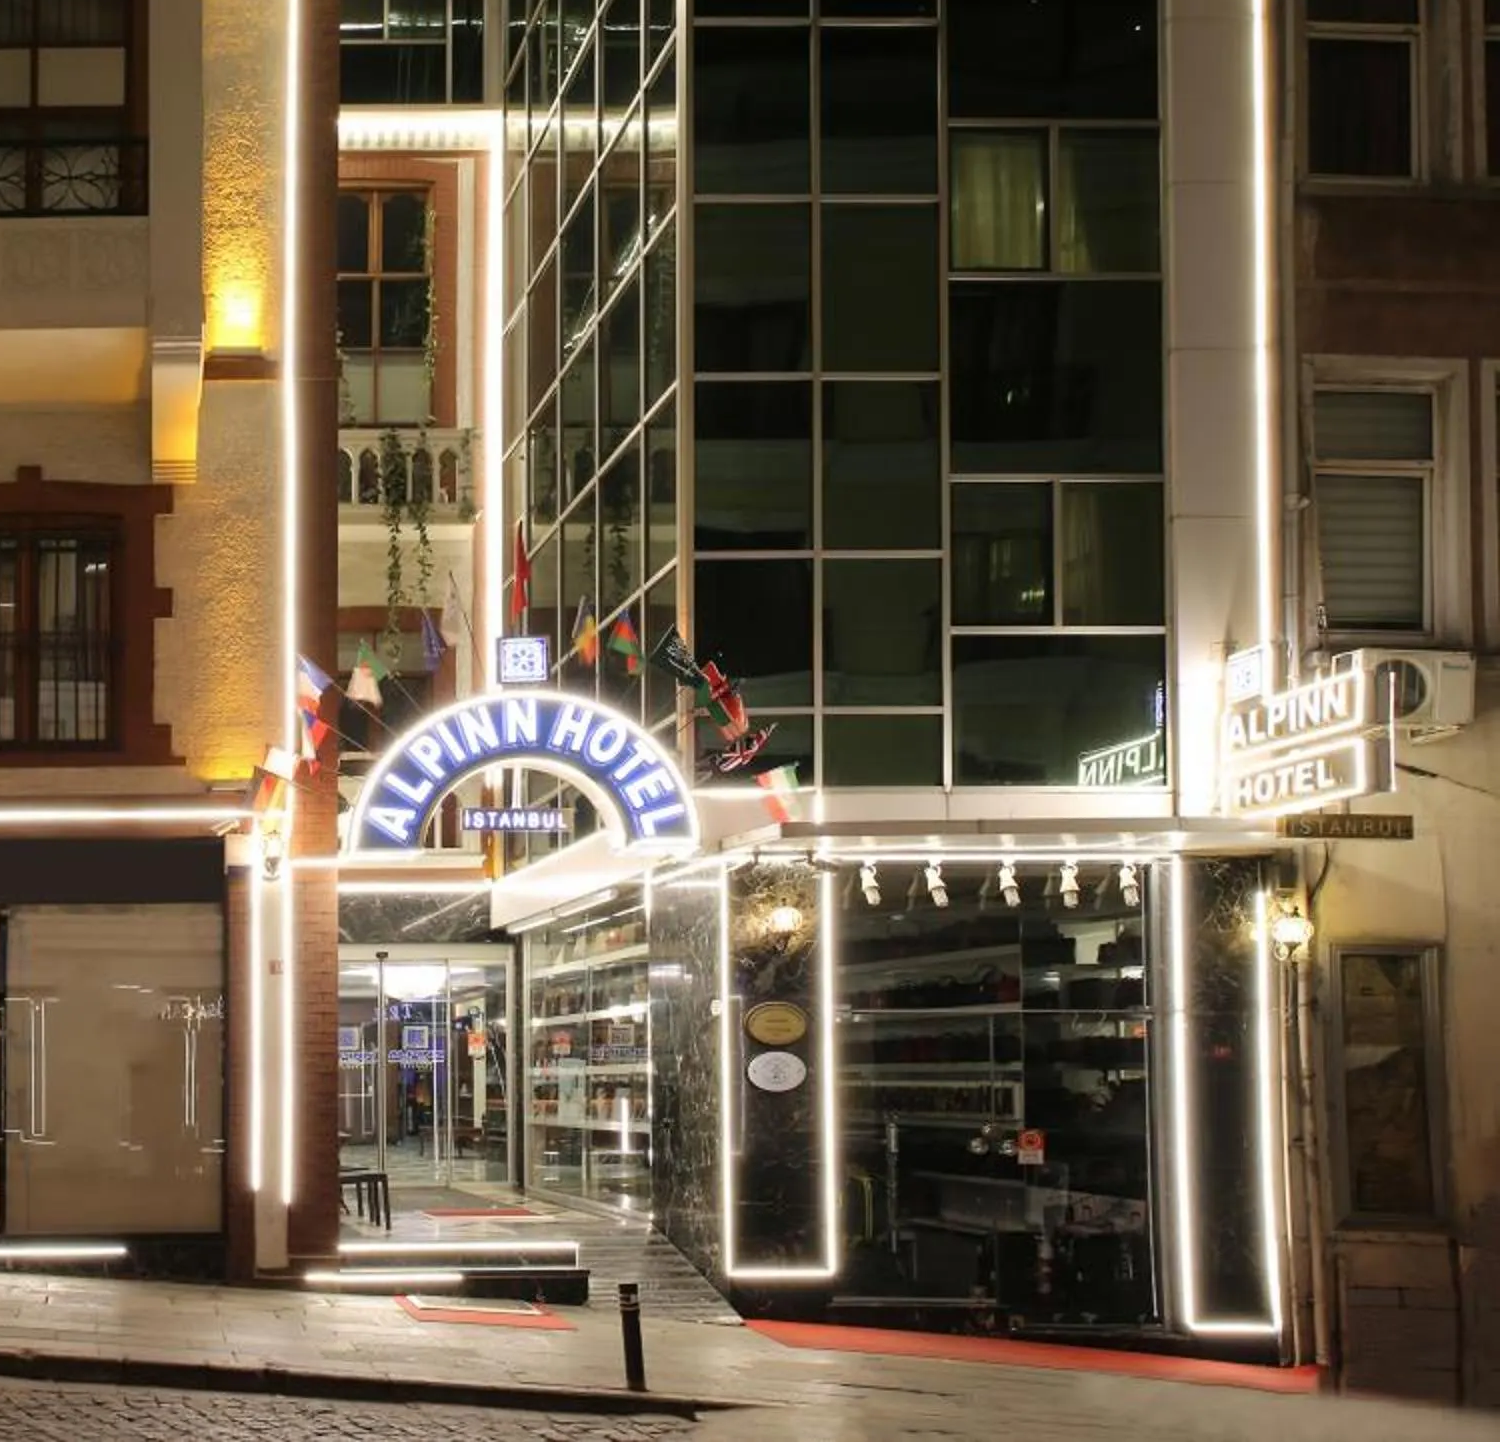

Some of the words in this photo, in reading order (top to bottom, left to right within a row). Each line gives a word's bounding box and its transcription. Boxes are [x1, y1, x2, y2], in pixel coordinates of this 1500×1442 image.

[1230, 681, 1348, 749] ALPINN
[367, 699, 537, 841] ALPINN
[551, 703, 687, 838] HOTEL
[1234, 758, 1336, 808] HOTEL
